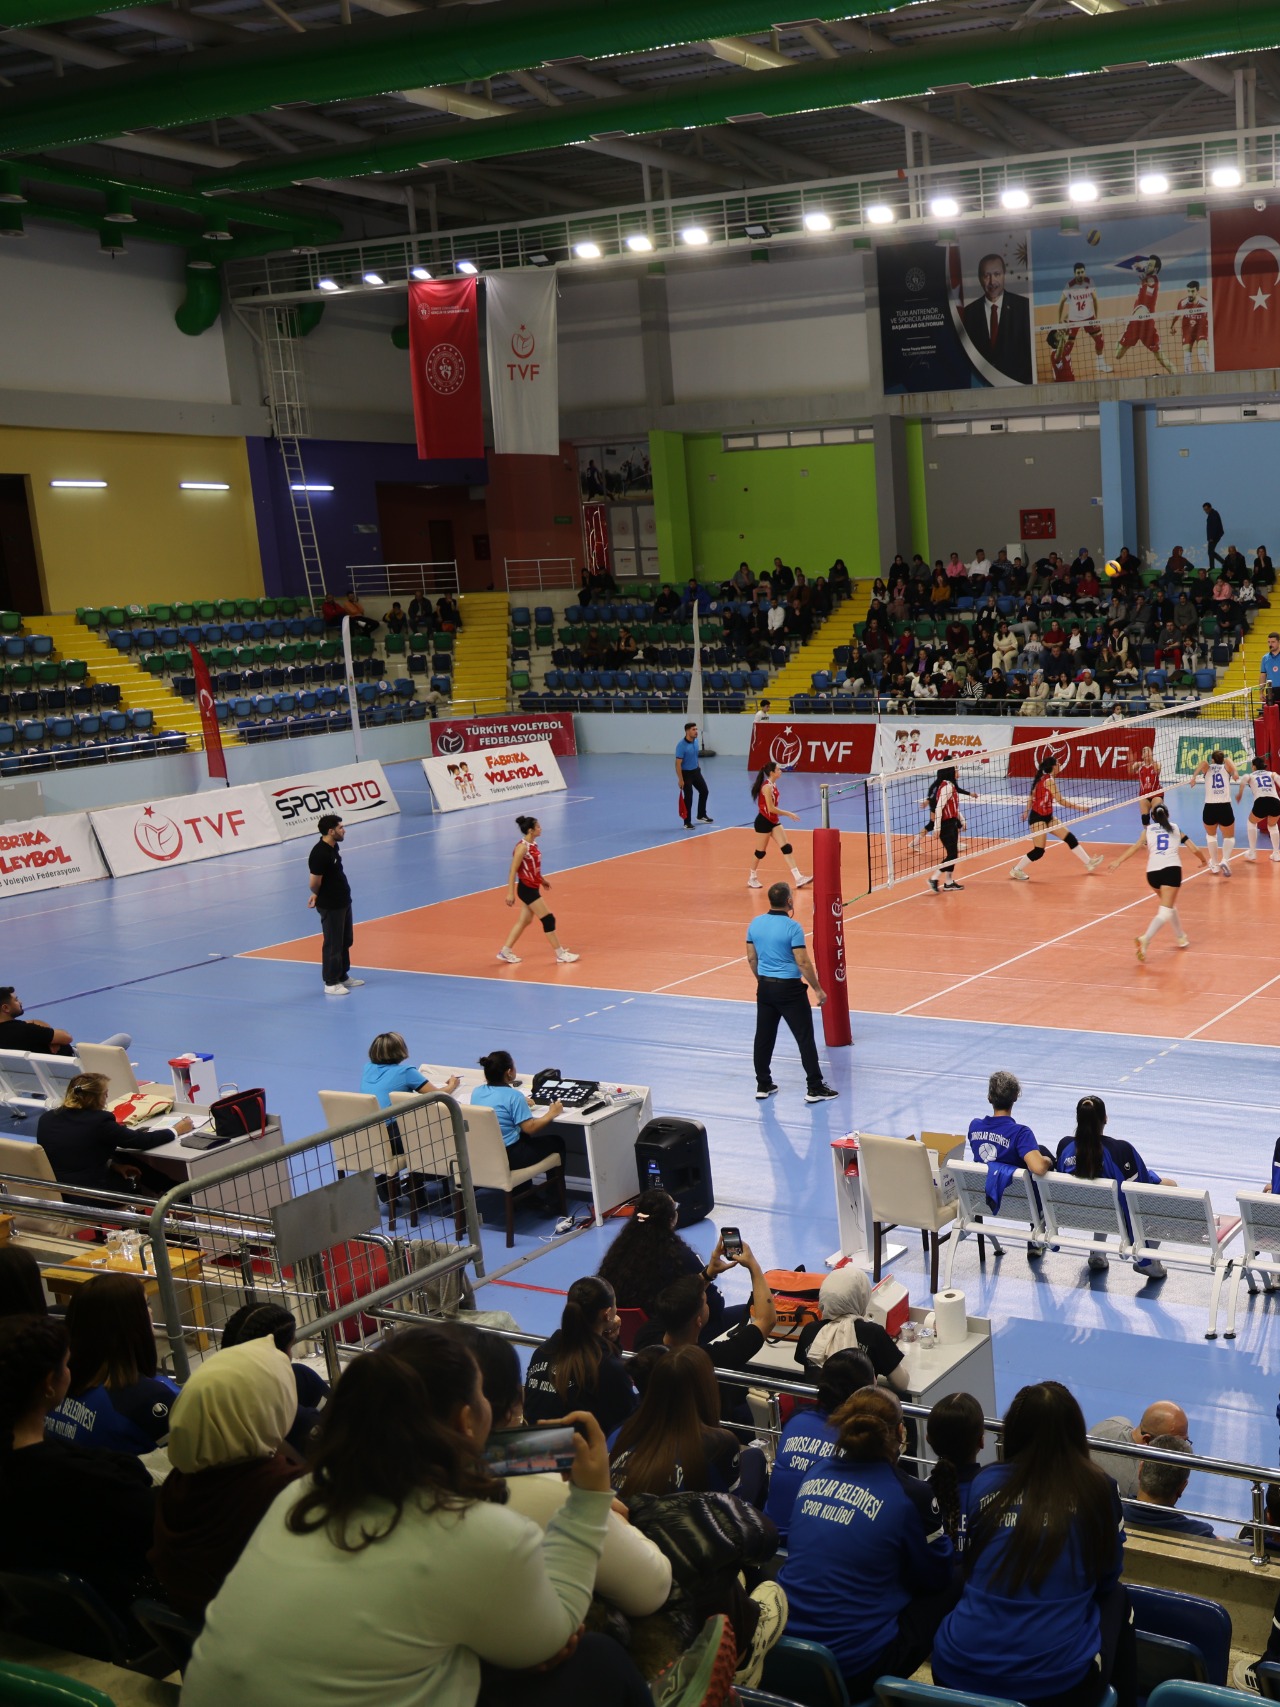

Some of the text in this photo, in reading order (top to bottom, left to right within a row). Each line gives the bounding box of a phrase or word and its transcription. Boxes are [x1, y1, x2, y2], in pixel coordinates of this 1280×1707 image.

[896, 307, 939, 317] TÜM ANTRENÖR
[507, 364, 540, 381] TVF
[466, 720, 564, 736] TÜRKİYE VOLEYBOL
[479, 733, 553, 746] FEDERASYONU
[807, 741, 854, 763] TVF
[1076, 745, 1130, 769] TVF
[484, 764, 544, 785] VOLEYBOL
[1211, 773, 1225, 789] 19
[1255, 775, 1273, 788] 12
[275, 780, 381, 819] SPORTOTO
[184, 809, 246, 844] TVF
[1156, 834, 1169, 851] 6
[3, 873, 36, 886] Voleybol
[36, 866, 81, 880] Federasyonu
[62, 1397, 97, 1432] BELEDİYESİ
[45, 1416, 77, 1440] POR KULÜBÜ
[782, 1436, 822, 1454] TOROSLAR
[790, 1455, 809, 1472] SPOR
[797, 1478, 884, 1522] TOROSLAR BELEDİYESİ
[801, 1499, 856, 1525] SPOR KULÜBÜ
